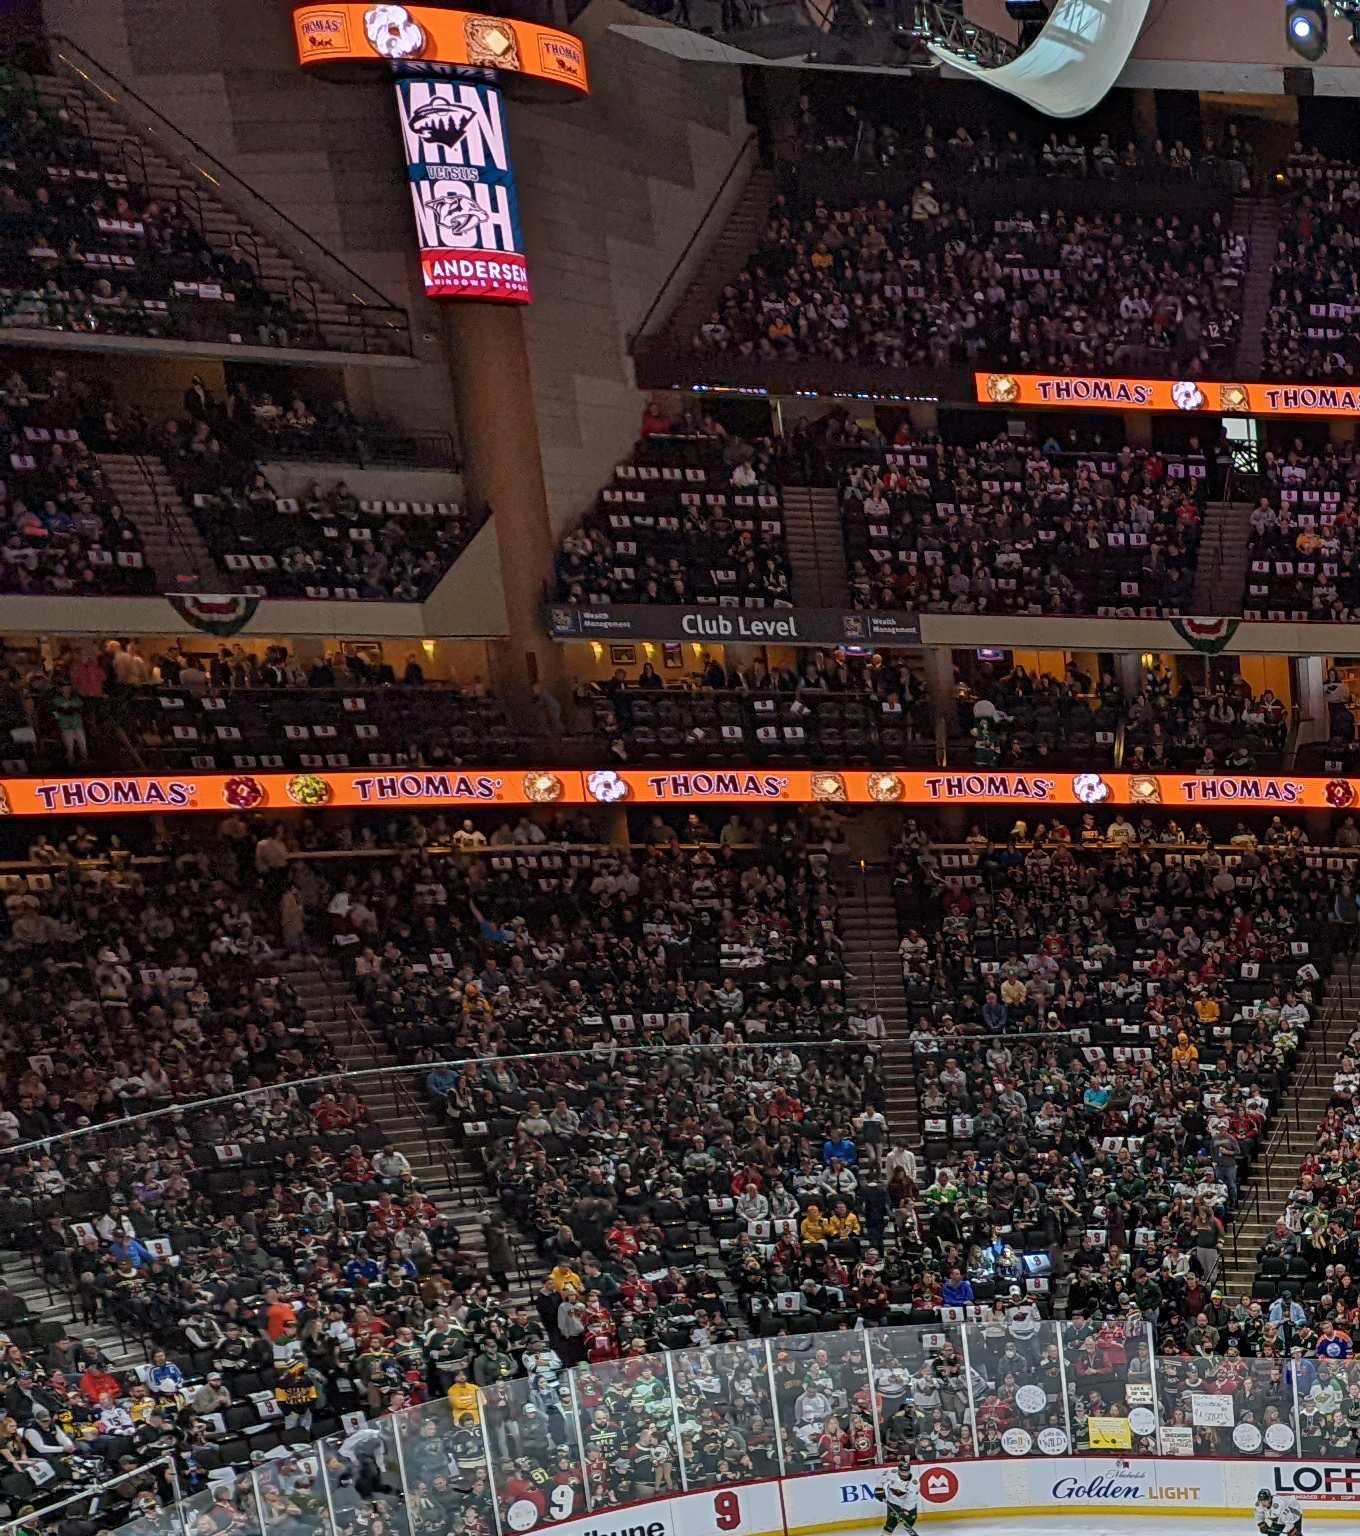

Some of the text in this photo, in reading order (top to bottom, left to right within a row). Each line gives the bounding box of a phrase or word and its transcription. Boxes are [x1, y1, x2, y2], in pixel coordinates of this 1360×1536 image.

[432, 260, 527, 281] ANDERSEN
[682, 614, 798, 636] Club Level
[841, 1485, 880, 1504] BM
[1052, 1475, 1200, 1500] Golden LIGHT
[550, 1484, 575, 1520] 9
[714, 1491, 742, 1531] 9
